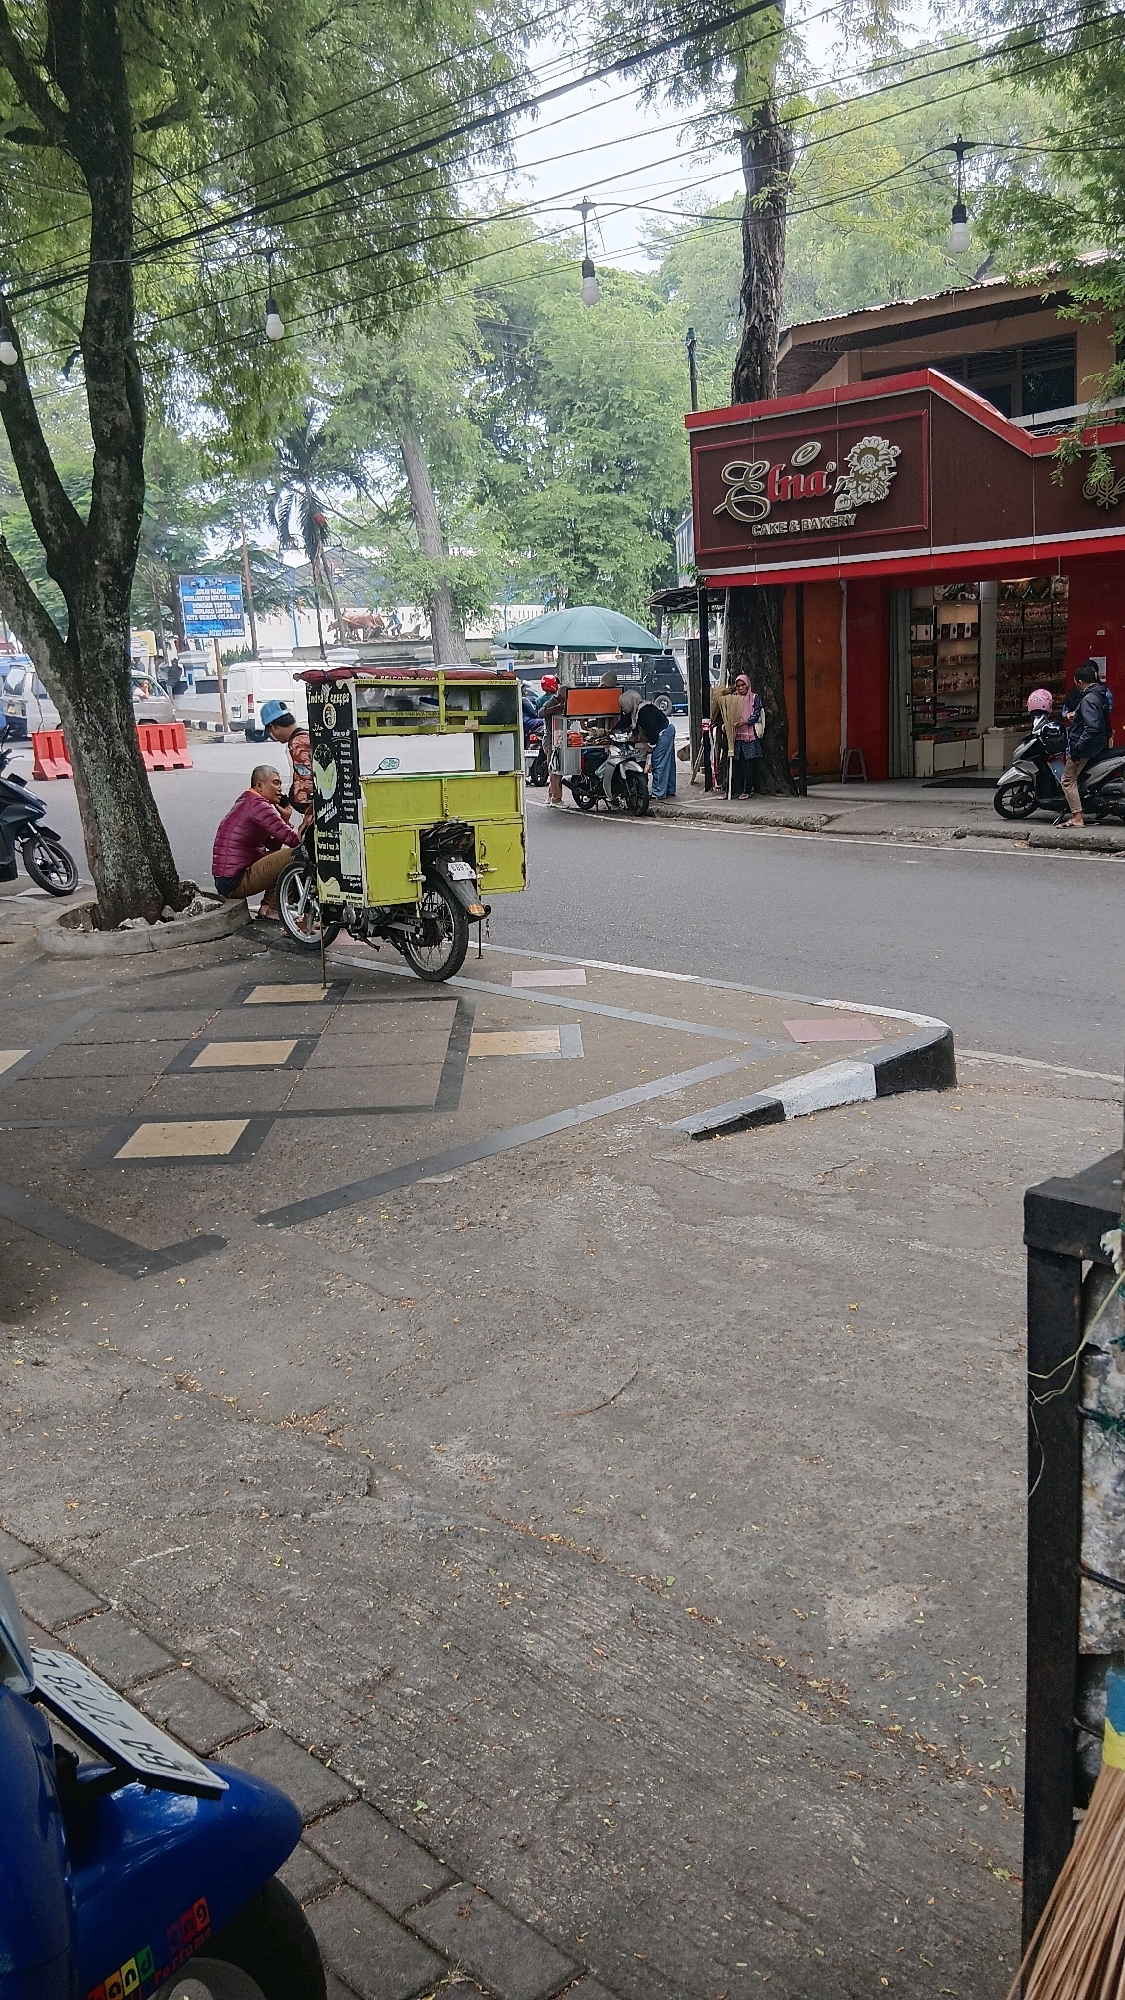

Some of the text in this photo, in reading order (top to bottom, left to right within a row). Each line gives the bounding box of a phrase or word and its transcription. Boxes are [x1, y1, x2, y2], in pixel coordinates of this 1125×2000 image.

[713, 460, 832, 523] Elna
[752, 513, 857, 536] CAKE & BAKERY
[119, 1738, 182, 1772] BA
